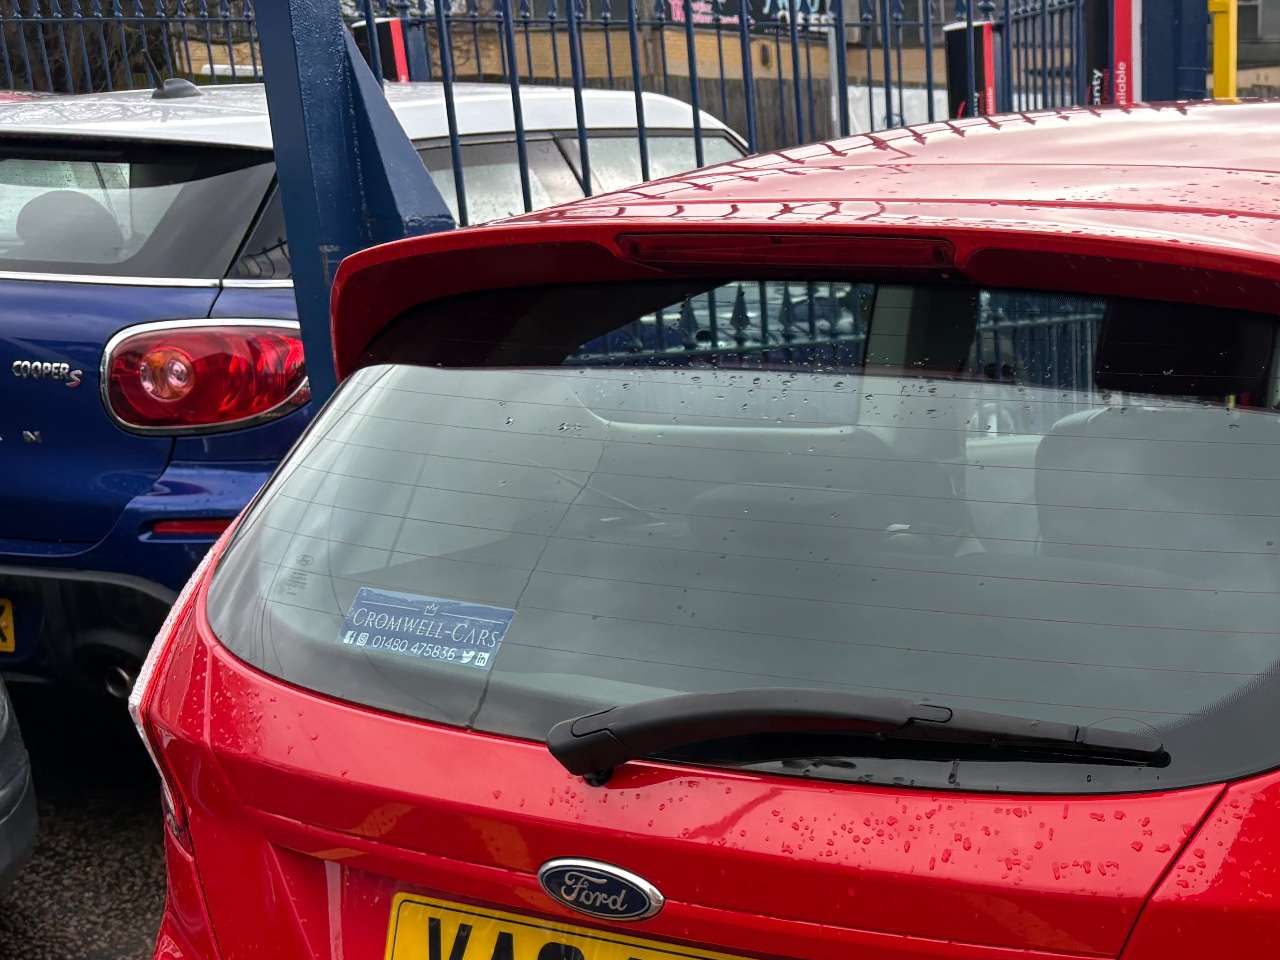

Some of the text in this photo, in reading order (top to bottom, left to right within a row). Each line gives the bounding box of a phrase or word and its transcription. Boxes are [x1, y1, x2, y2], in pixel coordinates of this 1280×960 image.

[12, 360, 70, 379] COOPER
[353, 608, 499, 648] CROMWELL-CARS
[372, 635, 456, 661] 01480 475836
[561, 872, 627, 911] Ford
